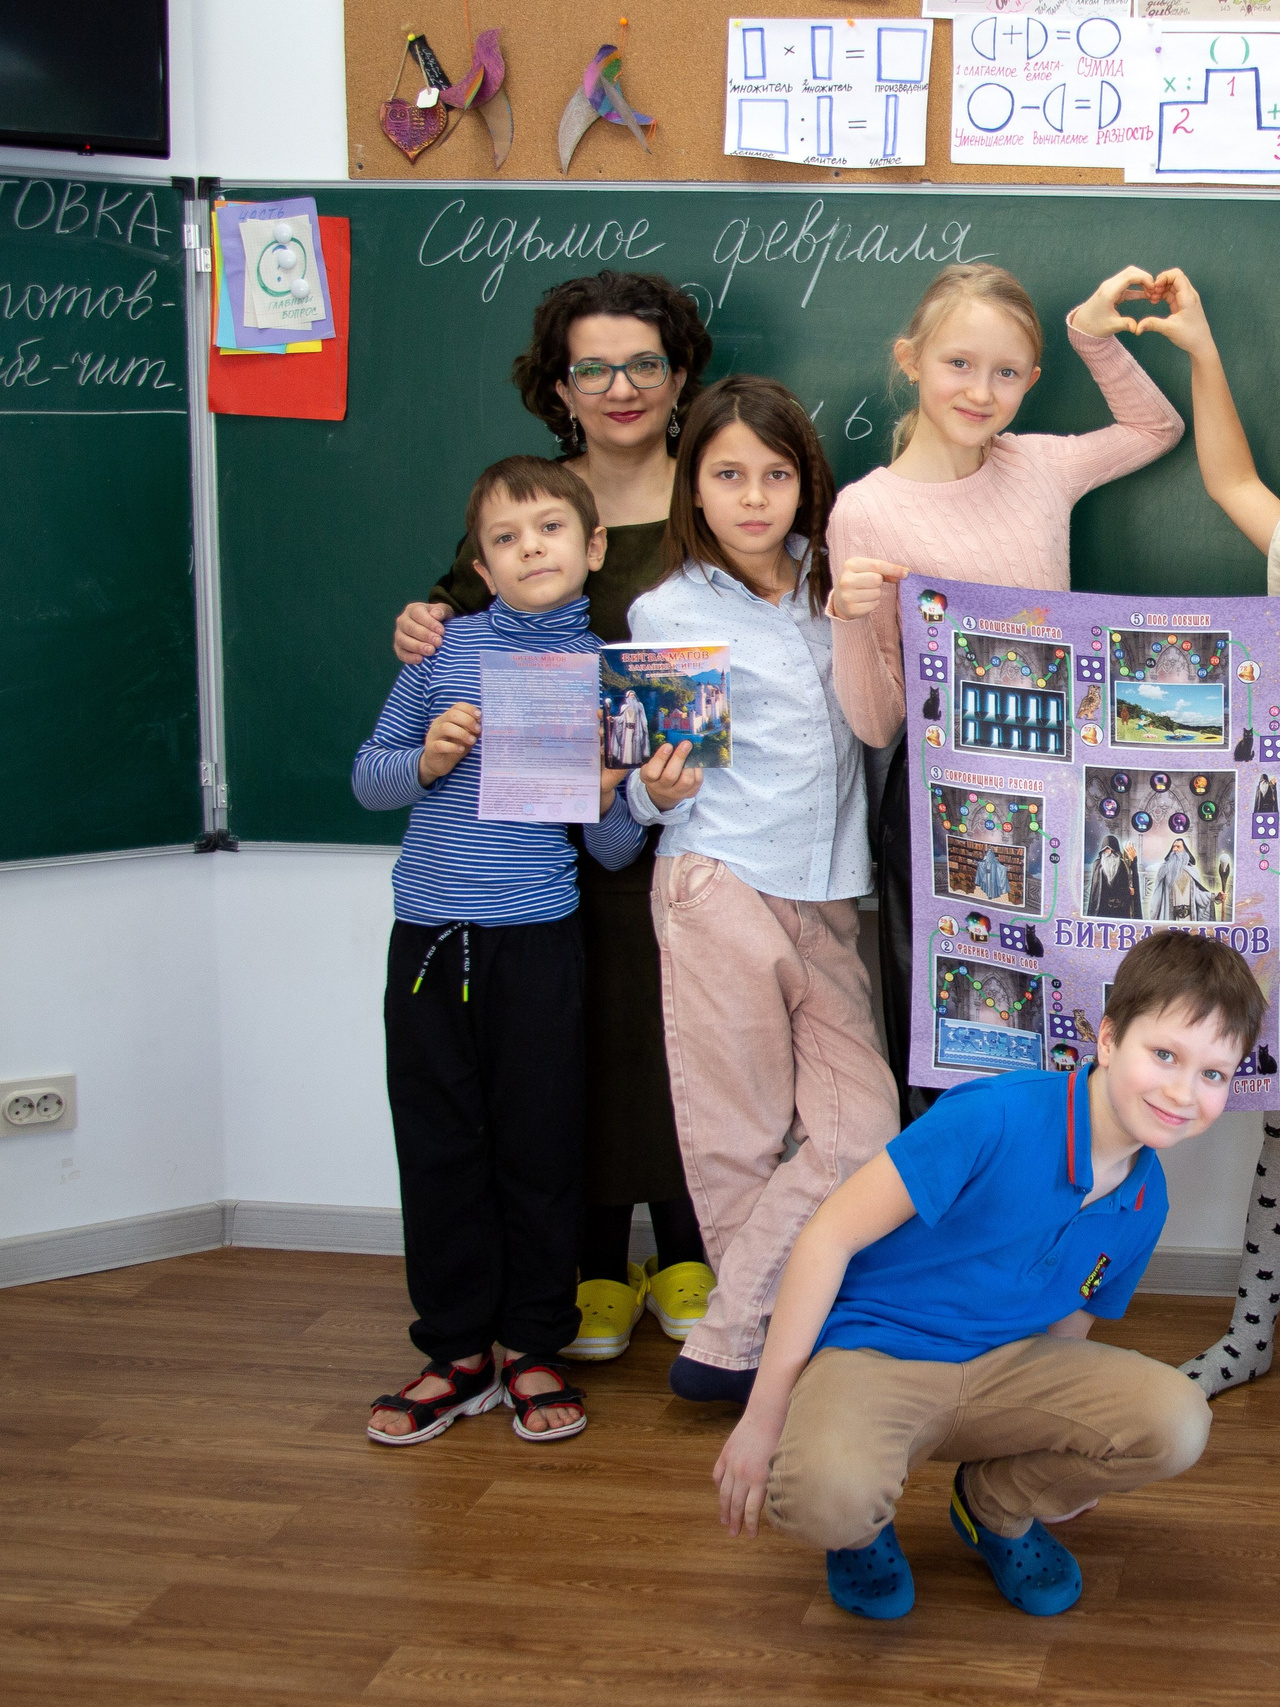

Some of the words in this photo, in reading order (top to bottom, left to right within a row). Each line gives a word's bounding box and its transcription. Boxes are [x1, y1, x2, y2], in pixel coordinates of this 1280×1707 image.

[1077, 57, 1125, 78] СУММА
[1226, 76, 1236, 97] 1
[1172, 108, 1194, 134] 2
[419, 199, 667, 303] Седьмое
[713, 199, 1000, 309] февраля
[1147, 614, 1168, 626] ПОЛЕ
[1172, 614, 1211, 626] ЛОВУШЕК
[668, 650, 709, 660] МАГОВ
[1234, 1078, 1271, 1094] СТАРТ
